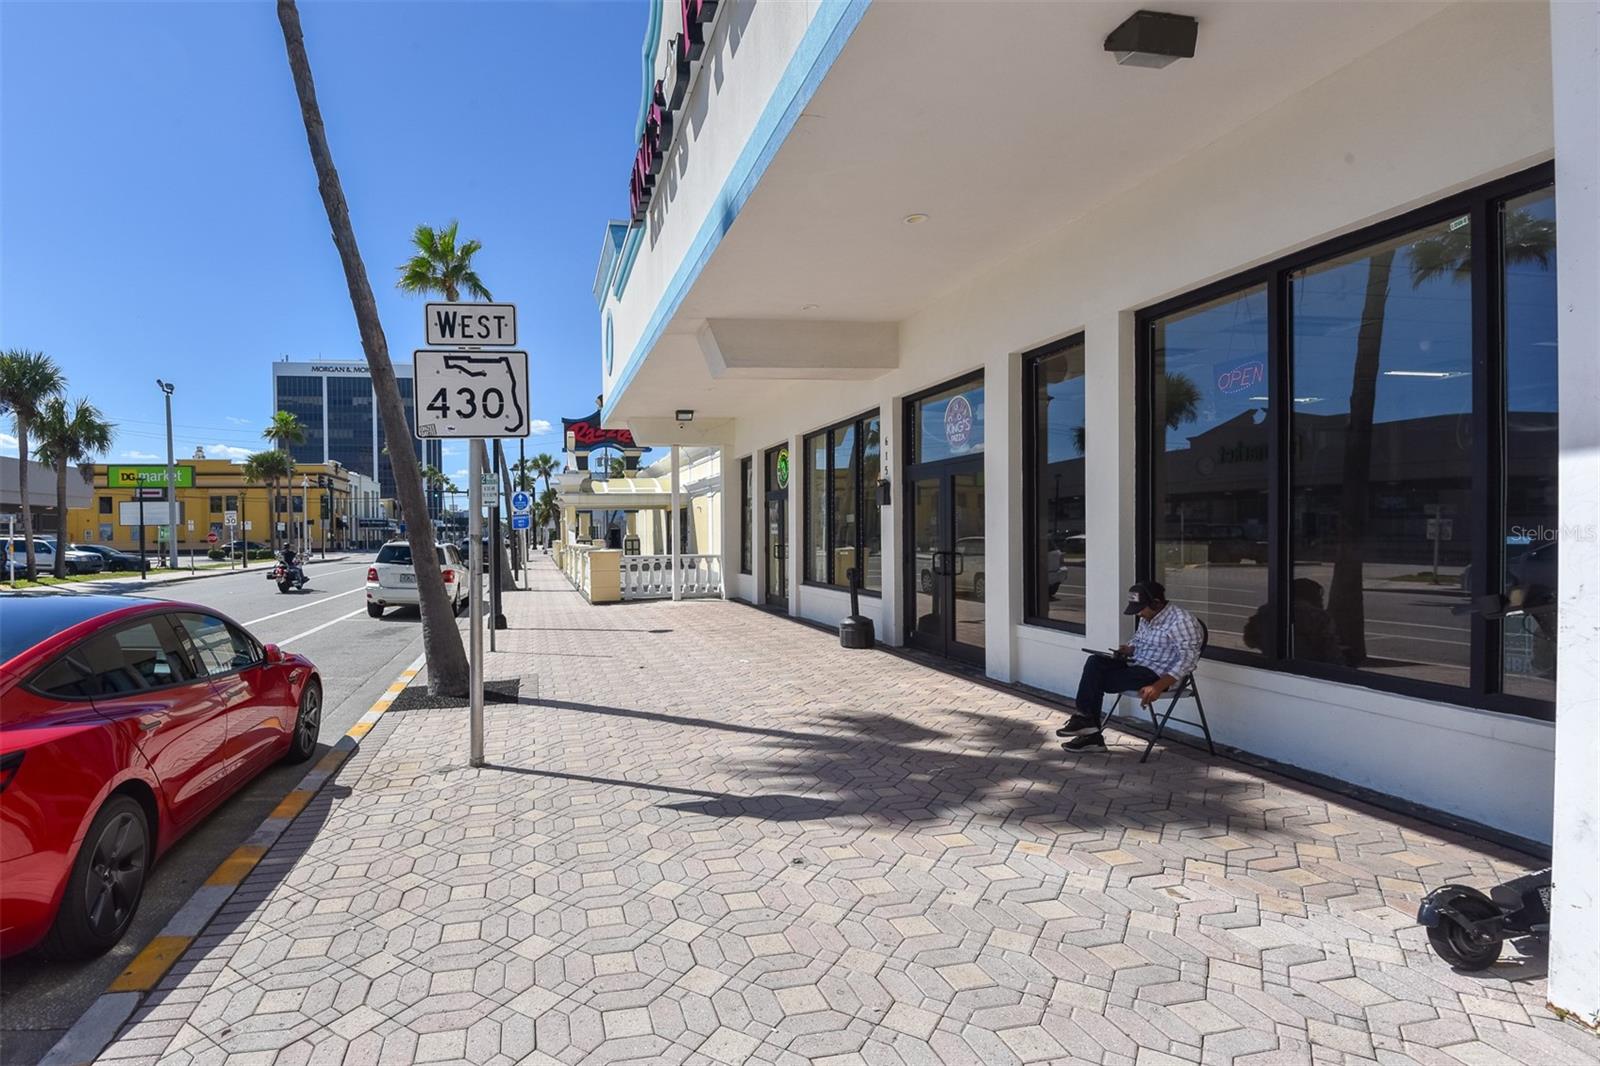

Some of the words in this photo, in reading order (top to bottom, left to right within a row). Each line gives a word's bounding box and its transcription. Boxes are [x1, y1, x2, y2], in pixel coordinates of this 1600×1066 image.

[436, 311, 505, 339] WEST
[1218, 363, 1264, 391] OPEN
[426, 387, 504, 419] 430
[946, 417, 971, 433] KING'S
[950, 432, 967, 442] PIZZA
[121, 473, 136, 481] DG
[138, 470, 183, 483] markt
